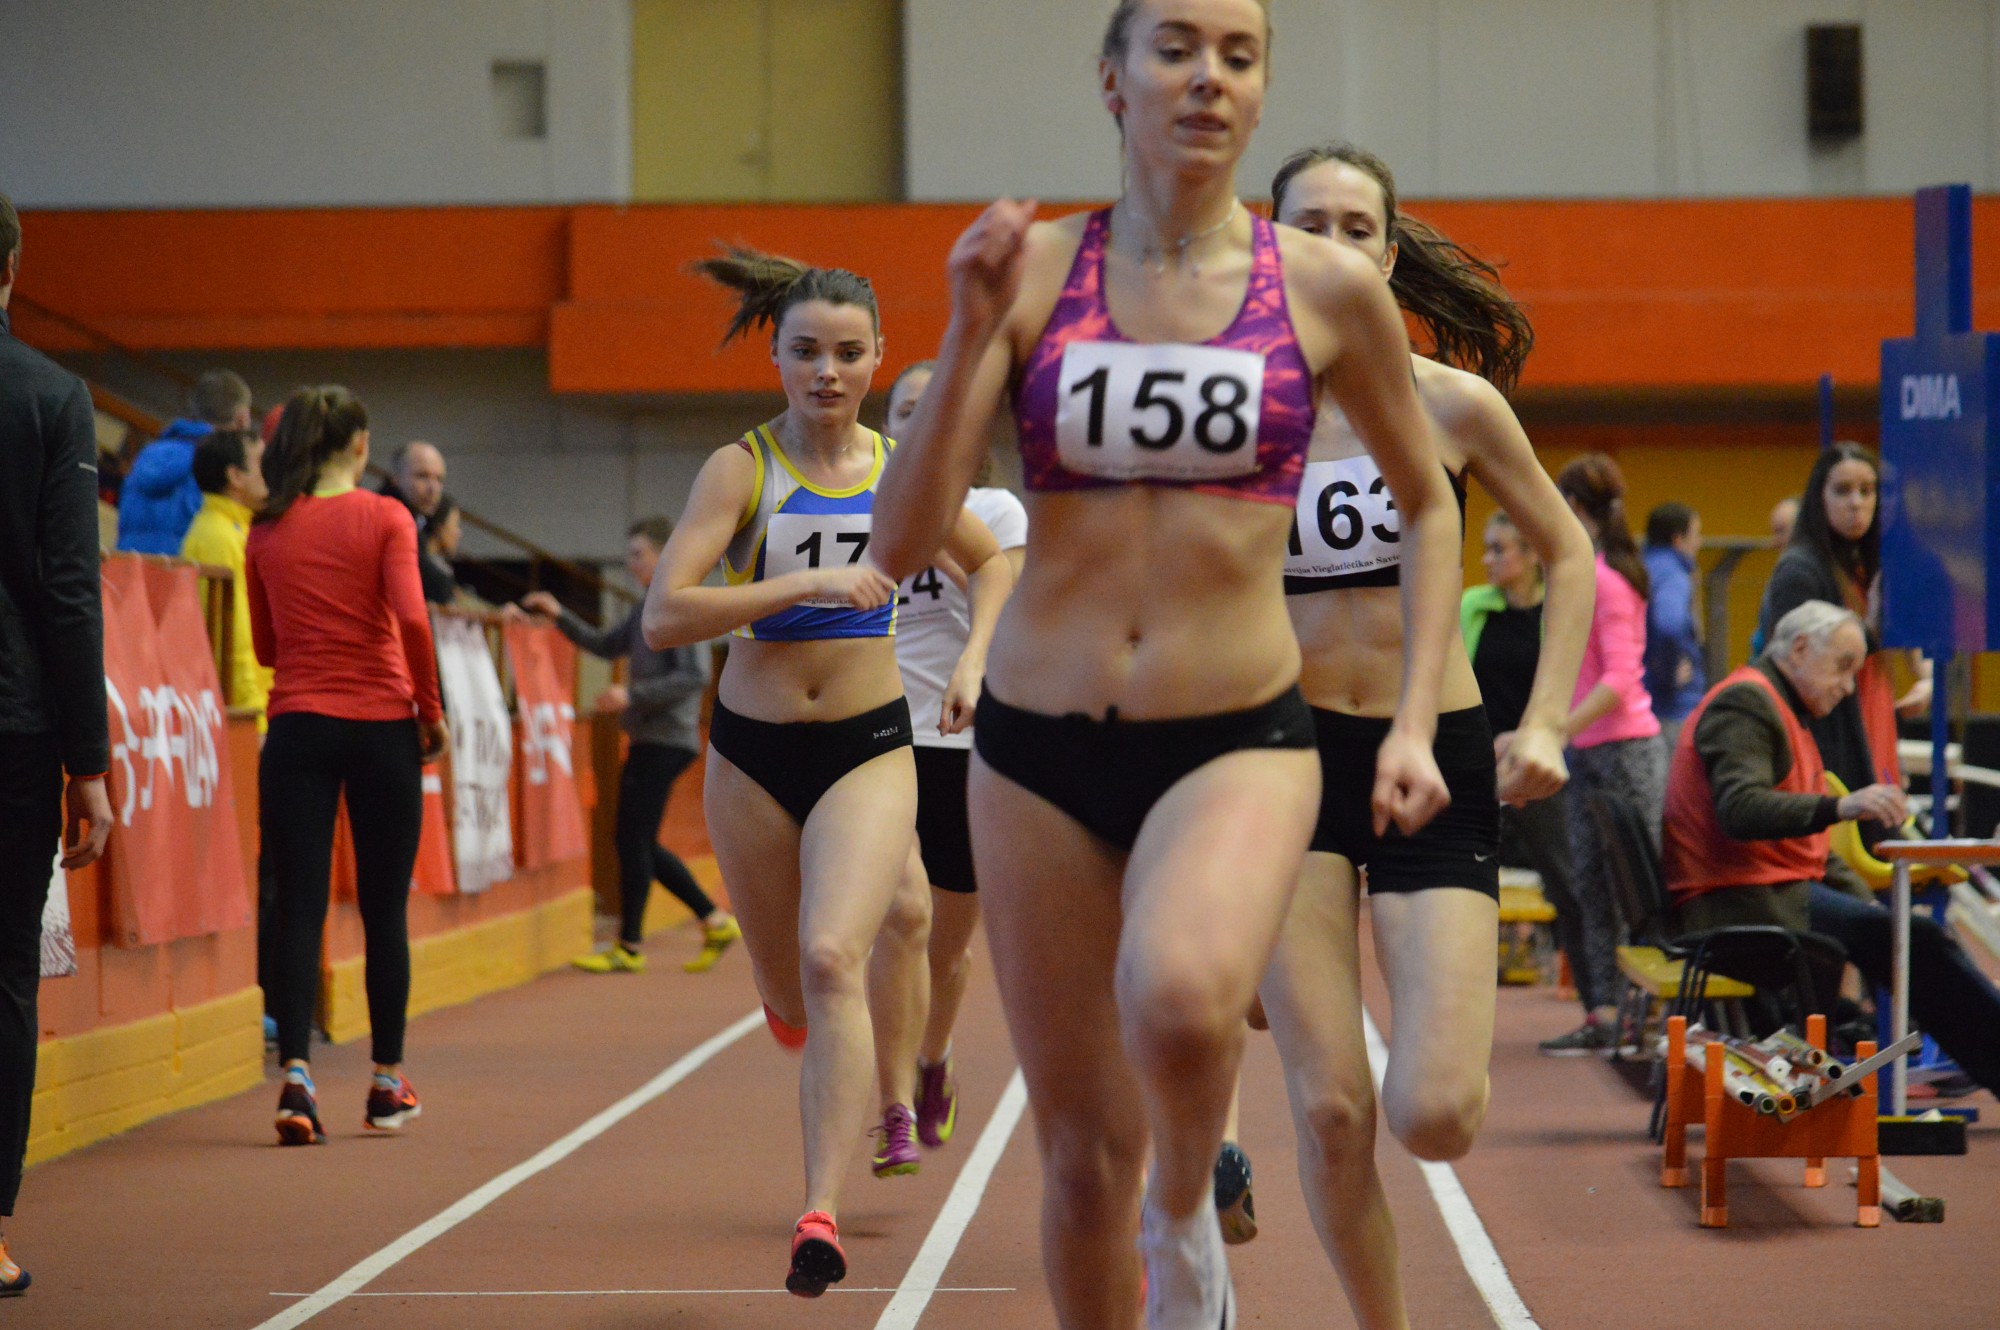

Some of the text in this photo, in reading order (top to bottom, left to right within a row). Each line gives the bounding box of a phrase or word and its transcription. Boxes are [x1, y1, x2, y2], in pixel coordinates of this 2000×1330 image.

[1070, 367, 1248, 454] 158
[1901, 374, 1961, 419] DIMA
[796, 531, 870, 568] 17
